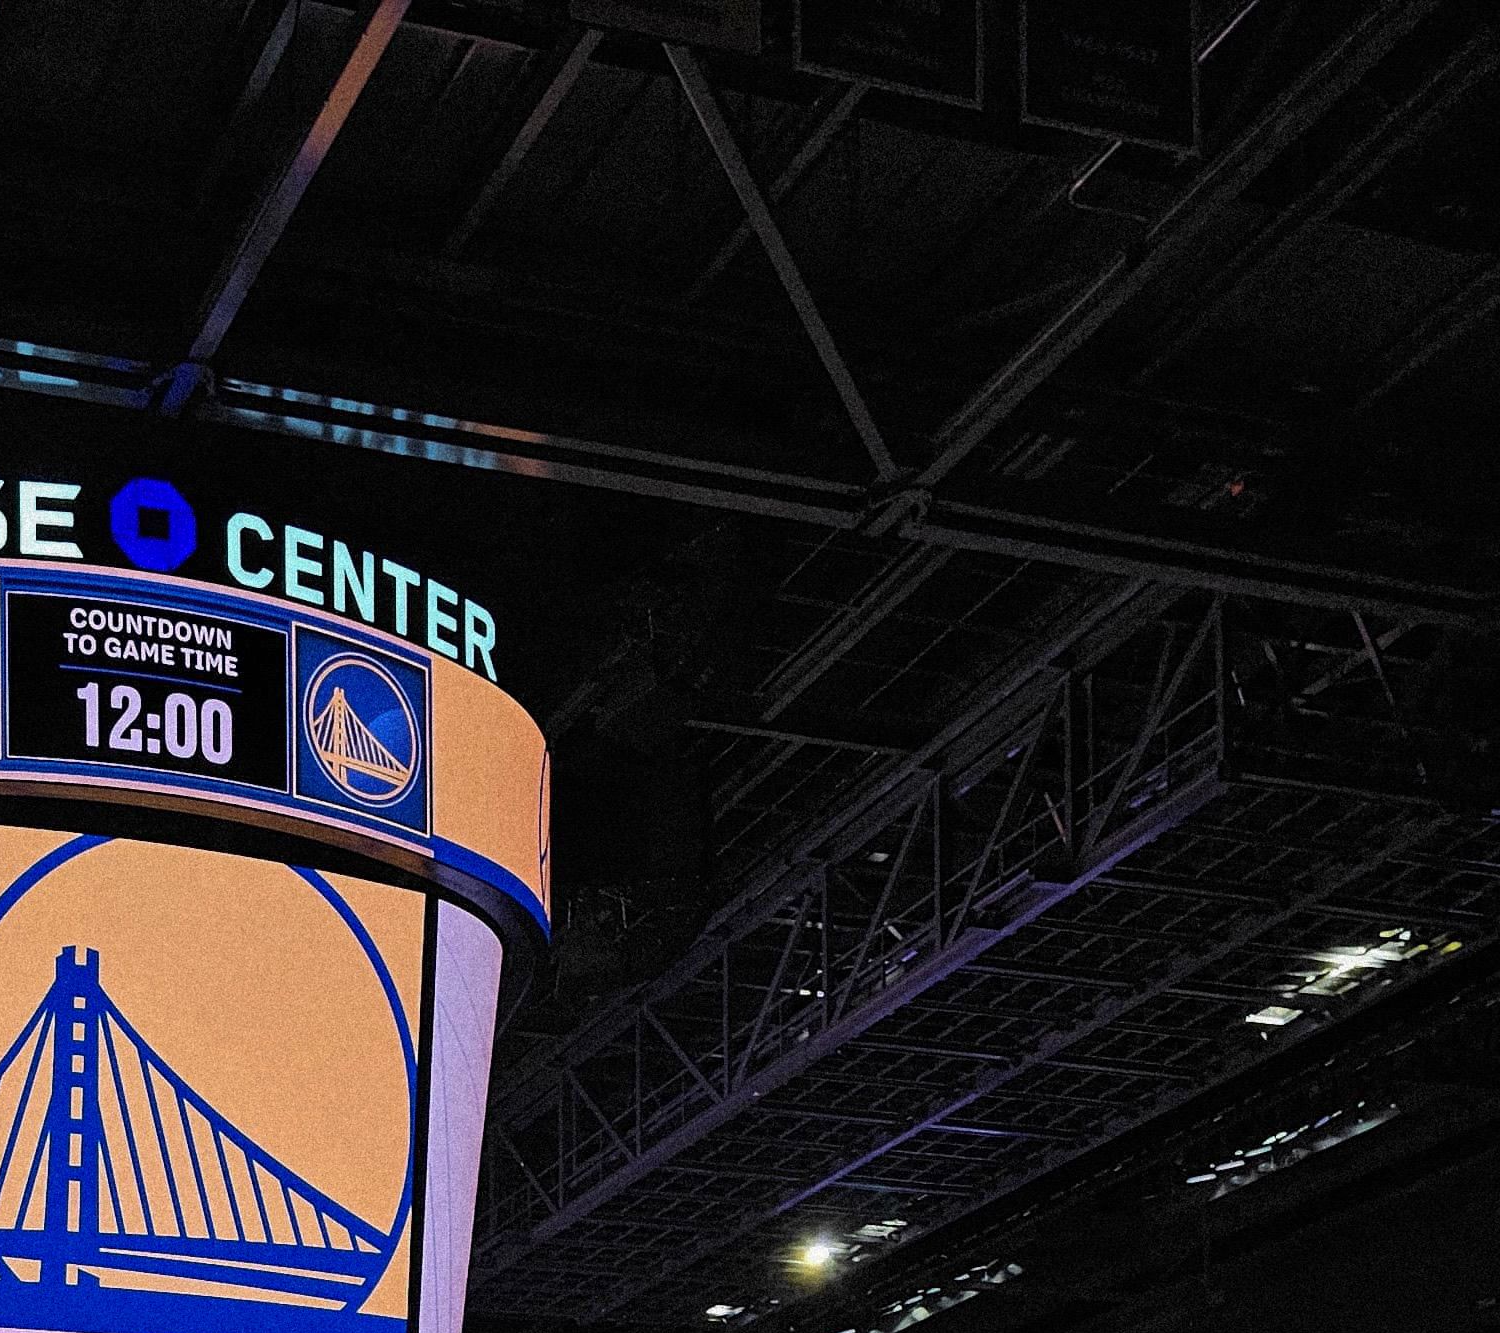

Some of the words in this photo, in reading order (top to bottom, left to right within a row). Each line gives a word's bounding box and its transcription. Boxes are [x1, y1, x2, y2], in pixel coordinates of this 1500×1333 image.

[69, 607, 232, 650] COUNTDOWN
[227, 512, 497, 682] CENTER
[63, 632, 97, 656] TO
[104, 637, 175, 666] GAME
[180, 647, 239, 677] TIME
[76, 681, 233, 765] 12:00
